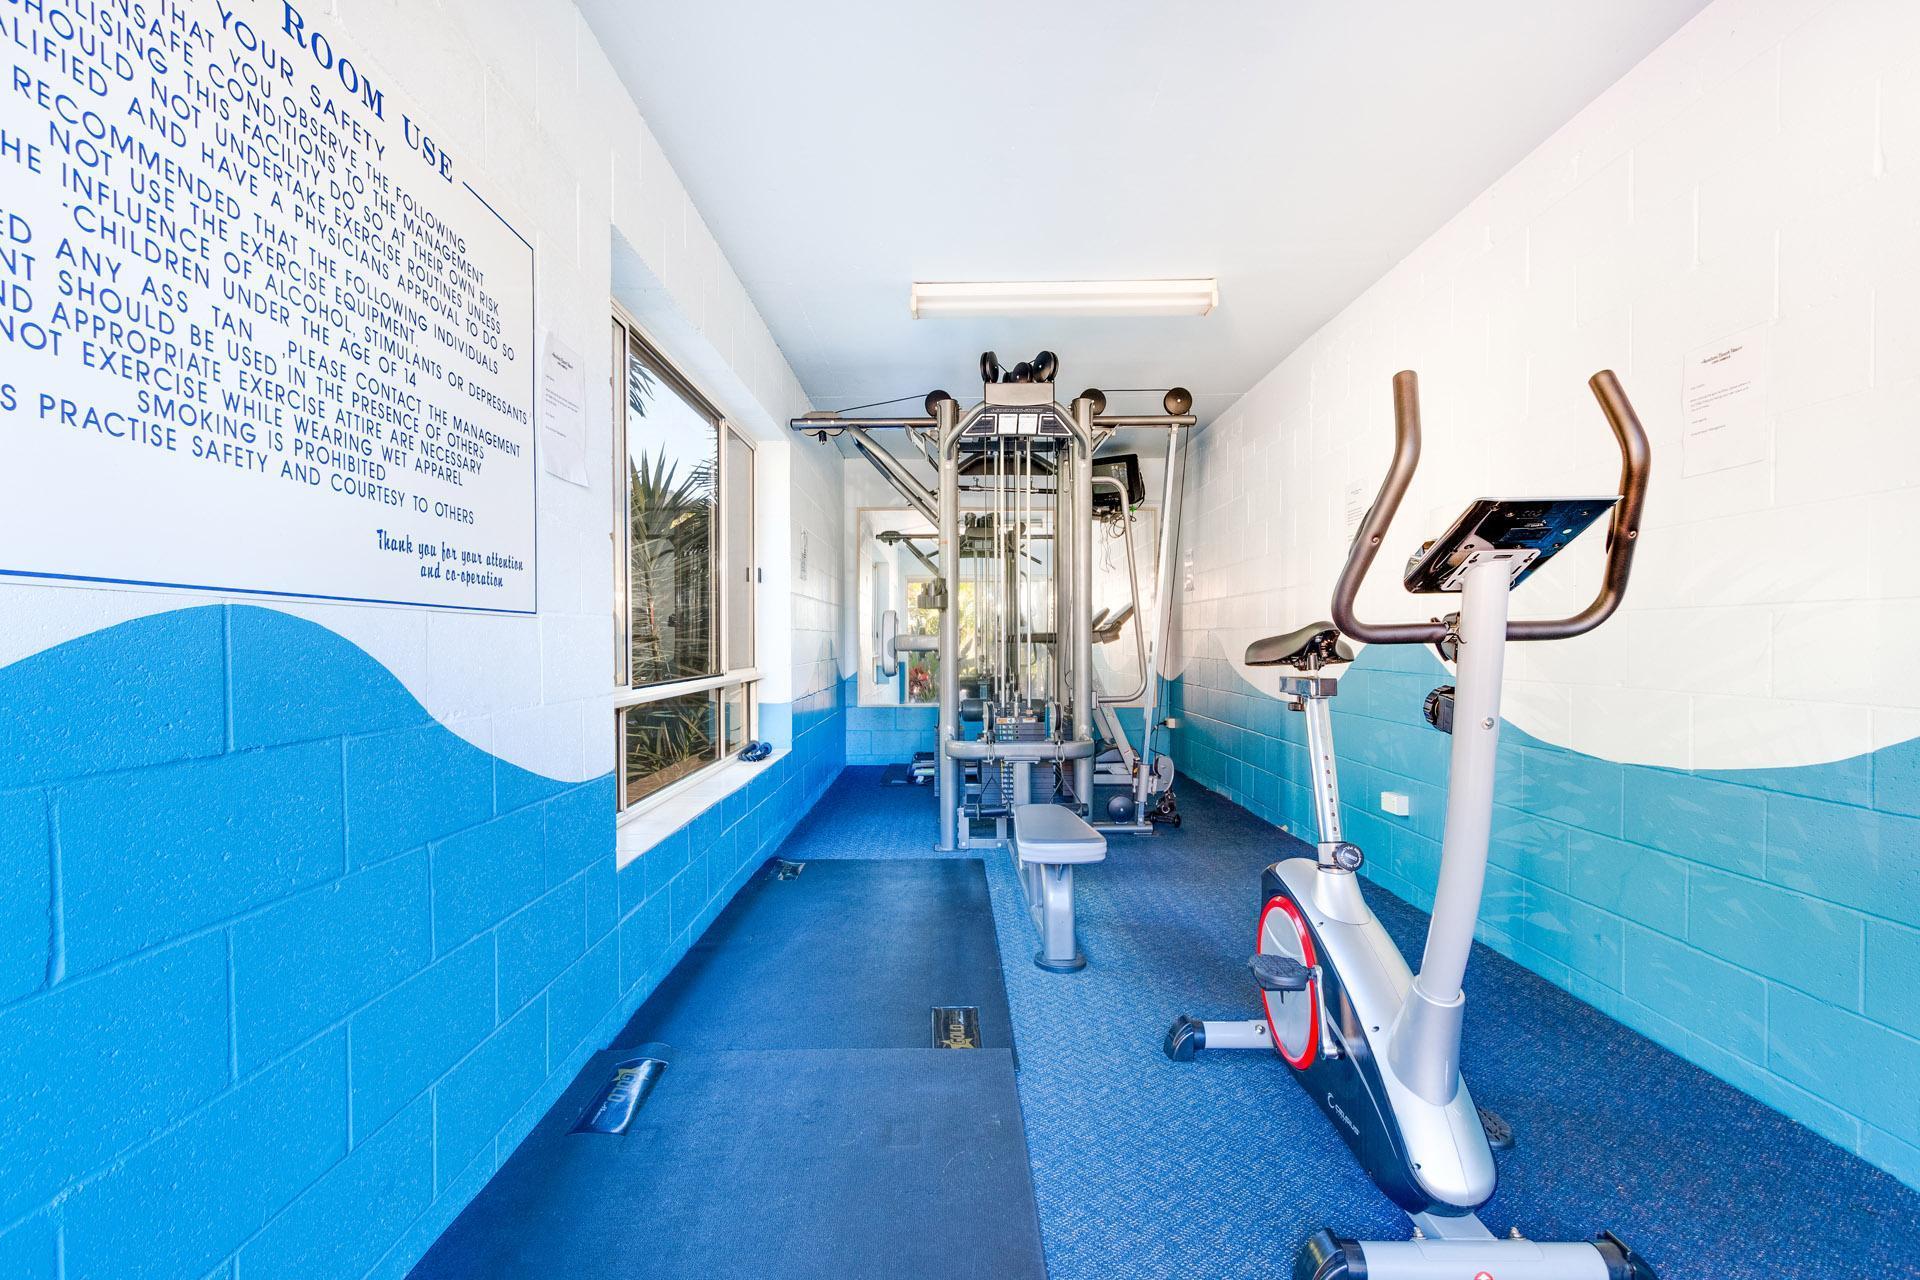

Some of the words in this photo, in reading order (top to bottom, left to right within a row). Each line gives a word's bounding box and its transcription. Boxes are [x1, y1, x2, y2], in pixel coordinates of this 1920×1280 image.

[8, 0, 134, 81] HOULD
[151, 77, 201, 128] NOT
[216, 122, 325, 215] UNDERTAKE
[335, 206, 400, 266] EXERCISE
[408, 258, 462, 308] ROUTINES
[468, 300, 500, 334] UNLESS
[66, 0, 168, 74] LISING
[184, 70, 229, 121] THIS
[243, 114, 320, 185] FACILITY
[330, 180, 354, 210] DO
[364, 206, 383, 230] SO
[392, 227, 405, 248] AT
[413, 241, 443, 276] THEIR
[449, 270, 474, 298] OWN
[480, 291, 498, 316] RISK
[216, 0, 294, 87] YOUR
[310, 84, 385, 161] SAFETY
[229, 48, 270, 98] YOU
[283, 96, 356, 168] OBSERVE
[366, 161, 388, 194] THE
[396, 186, 466, 254] FOLLOWING
[282, 0, 384, 122] ROOM
[402, 114, 452, 184] USE
[14, 64, 240, 220] RECOMMENDED
[254, 212, 298, 254] THAT
[309, 247, 336, 279] THE
[346, 269, 427, 331] FOLLOWING
[434, 324, 498, 374] INDIVIDUALS
[50, 120, 112, 176] NOT
[131, 168, 174, 213] USE
[190, 202, 227, 242] THE
[241, 232, 325, 296] EXERCISE
[128, 97, 186, 148] AND
[202, 142, 258, 196] HAVE
[271, 191, 283, 213] A
[295, 204, 389, 280] PHYSICIANS
[398, 274, 459, 326] APPROVAL
[466, 318, 478, 337] TO
[483, 330, 497, 350] DO
[503, 344, 514, 360] SO
[209, 64, 335, 174] CONDITIONS
[345, 168, 364, 194] TO
[373, 189, 396, 220] THE
[404, 213, 484, 286] MANAGEMENT
[56, 238, 122, 283] ANY
[141, 276, 188, 313] ASS
[212, 305, 252, 342] TAN
[356, 372, 421, 414] CONTACT
[429, 404, 447, 426] THE
[454, 416, 520, 457] MANAGEMENT
[58, 270, 174, 335] SHOULD
[190, 324, 214, 352] BE
[228, 339, 277, 376] USED
[289, 365, 305, 388] IN
[316, 376, 343, 403] THE
[352, 392, 418, 433] PRESENCE
[426, 424, 440, 441] OF
[447, 432, 484, 459] OTHERS
[63, 162, 209, 260] INFLUENCE
[224, 252, 252, 280] OF
[265, 274, 355, 338] ALCOHOL,
[365, 326, 442, 380] STIMULANTS
[448, 372, 463, 391] OR
[469, 382, 527, 424] DEPRESSANTS
[224, 277, 289, 327] UNDER
[301, 316, 329, 346] THE
[340, 337, 370, 365] AGE
[379, 356, 396, 376] OF
[404, 368, 416, 387] 14
[40, 393, 176, 451] PRACTISE
[192, 436, 268, 472] SAFETY
[281, 460, 320, 485] AND
[331, 474, 405, 507] COURTESY
[413, 496, 428, 513] TO
[435, 502, 474, 524] OTHERS
[51, 302, 220, 382] APPROPRIATE
[240, 370, 325, 419] EXERCISE
[336, 408, 382, 439] ATTIRE
[390, 429, 414, 451] ARE
[421, 440, 481, 474] NECESSARY
[83, 341, 207, 404] EXERCISE
[222, 389, 282, 428] WHILE
[294, 414, 372, 456] WEARING
[381, 445, 407, 468] WET
[415, 457, 462, 486] APPAREL
[138, 390, 256, 444] SMOKING
[269, 430, 283, 452] IS
[294, 438, 385, 480] PROHIBITED
[376, 529, 412, 553] Thank
[418, 544, 437, 560] you
[441, 541, 457, 562] for
[462, 551, 482, 566] your
[486, 552, 524, 571] attention
[421, 562, 441, 579] and
[446, 569, 504, 588] co-operation
